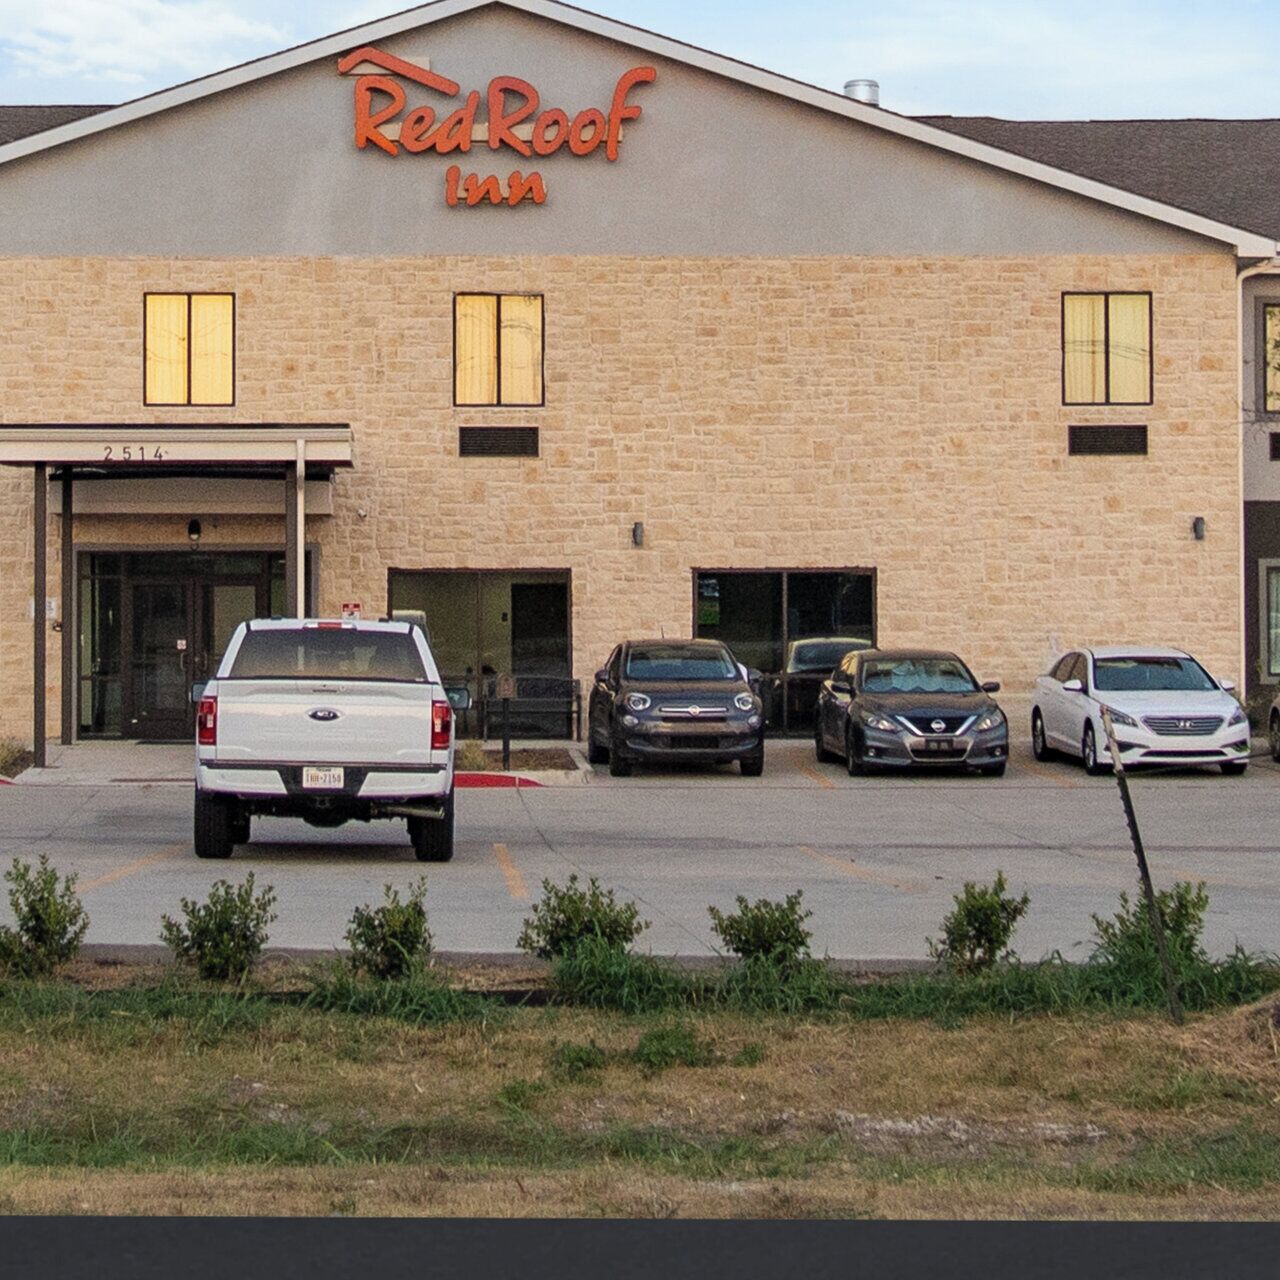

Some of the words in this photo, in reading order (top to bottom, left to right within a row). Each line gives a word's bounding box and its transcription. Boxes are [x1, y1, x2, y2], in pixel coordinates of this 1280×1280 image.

[354, 76, 480, 156] Red
[488, 66, 657, 160] Roof
[446, 165, 546, 206] Inn
[104, 445, 163, 461] 2514
